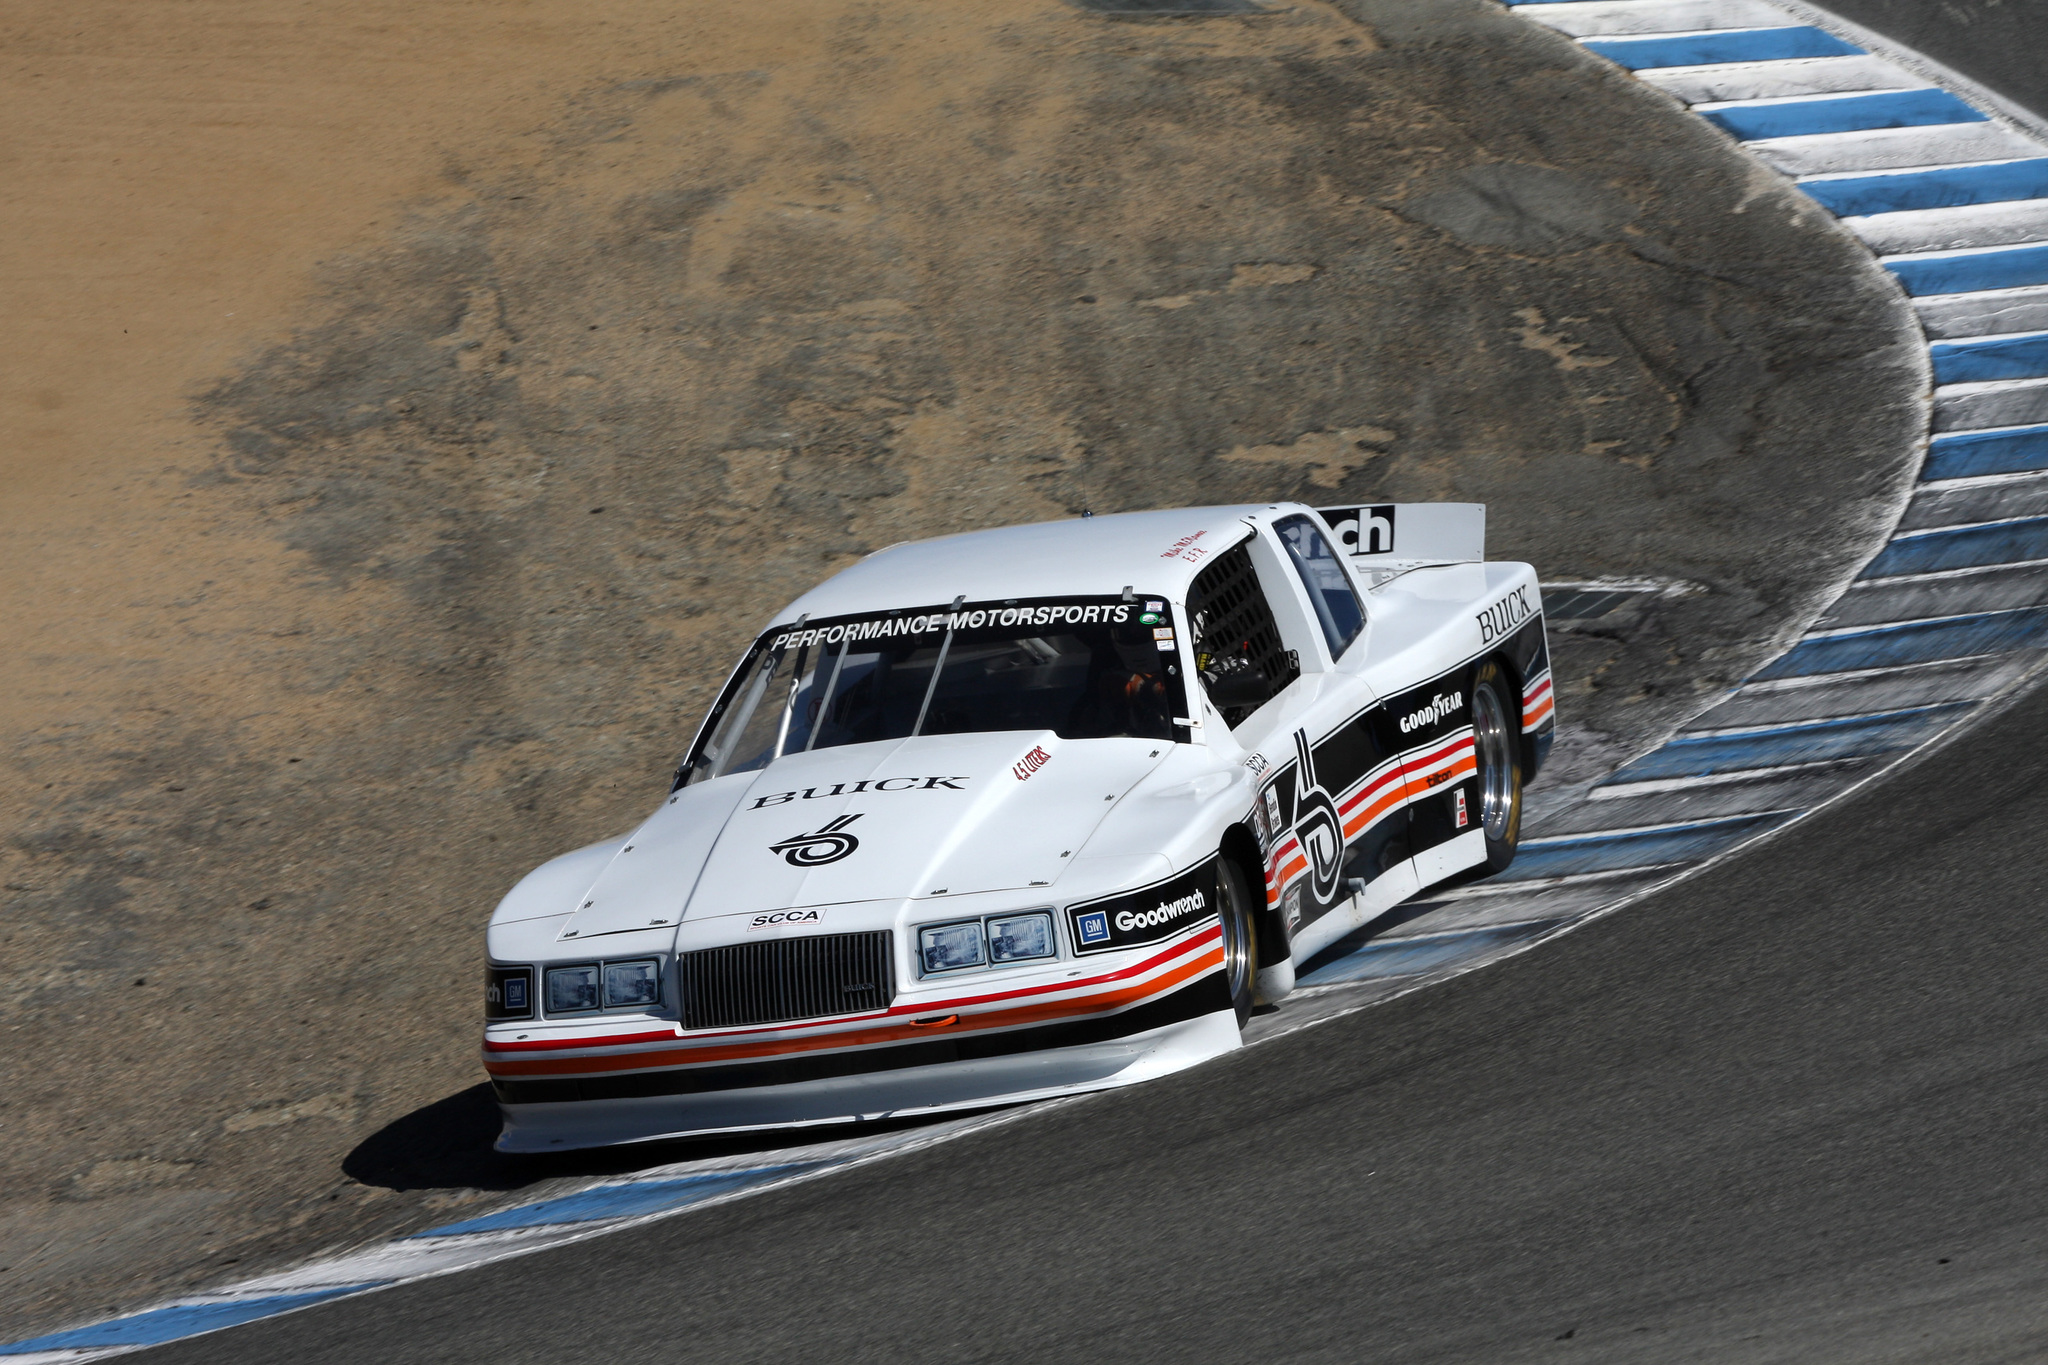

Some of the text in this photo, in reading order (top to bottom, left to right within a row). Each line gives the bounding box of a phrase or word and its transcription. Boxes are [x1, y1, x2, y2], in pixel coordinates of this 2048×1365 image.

[771, 605, 1129, 651] PERFORMANCE MOTORSPORTS
[1476, 584, 1531, 645] BUICK
[1400, 691, 1463, 733] GOODYEAR
[1022, 745, 1052, 773] LITERS
[746, 776, 970, 811] BUICK
[752, 910, 818, 926] SCCA
[1085, 919, 1102, 933] GM
[1115, 889, 1205, 931] Goodwrench
[510, 985, 522, 999] GM
